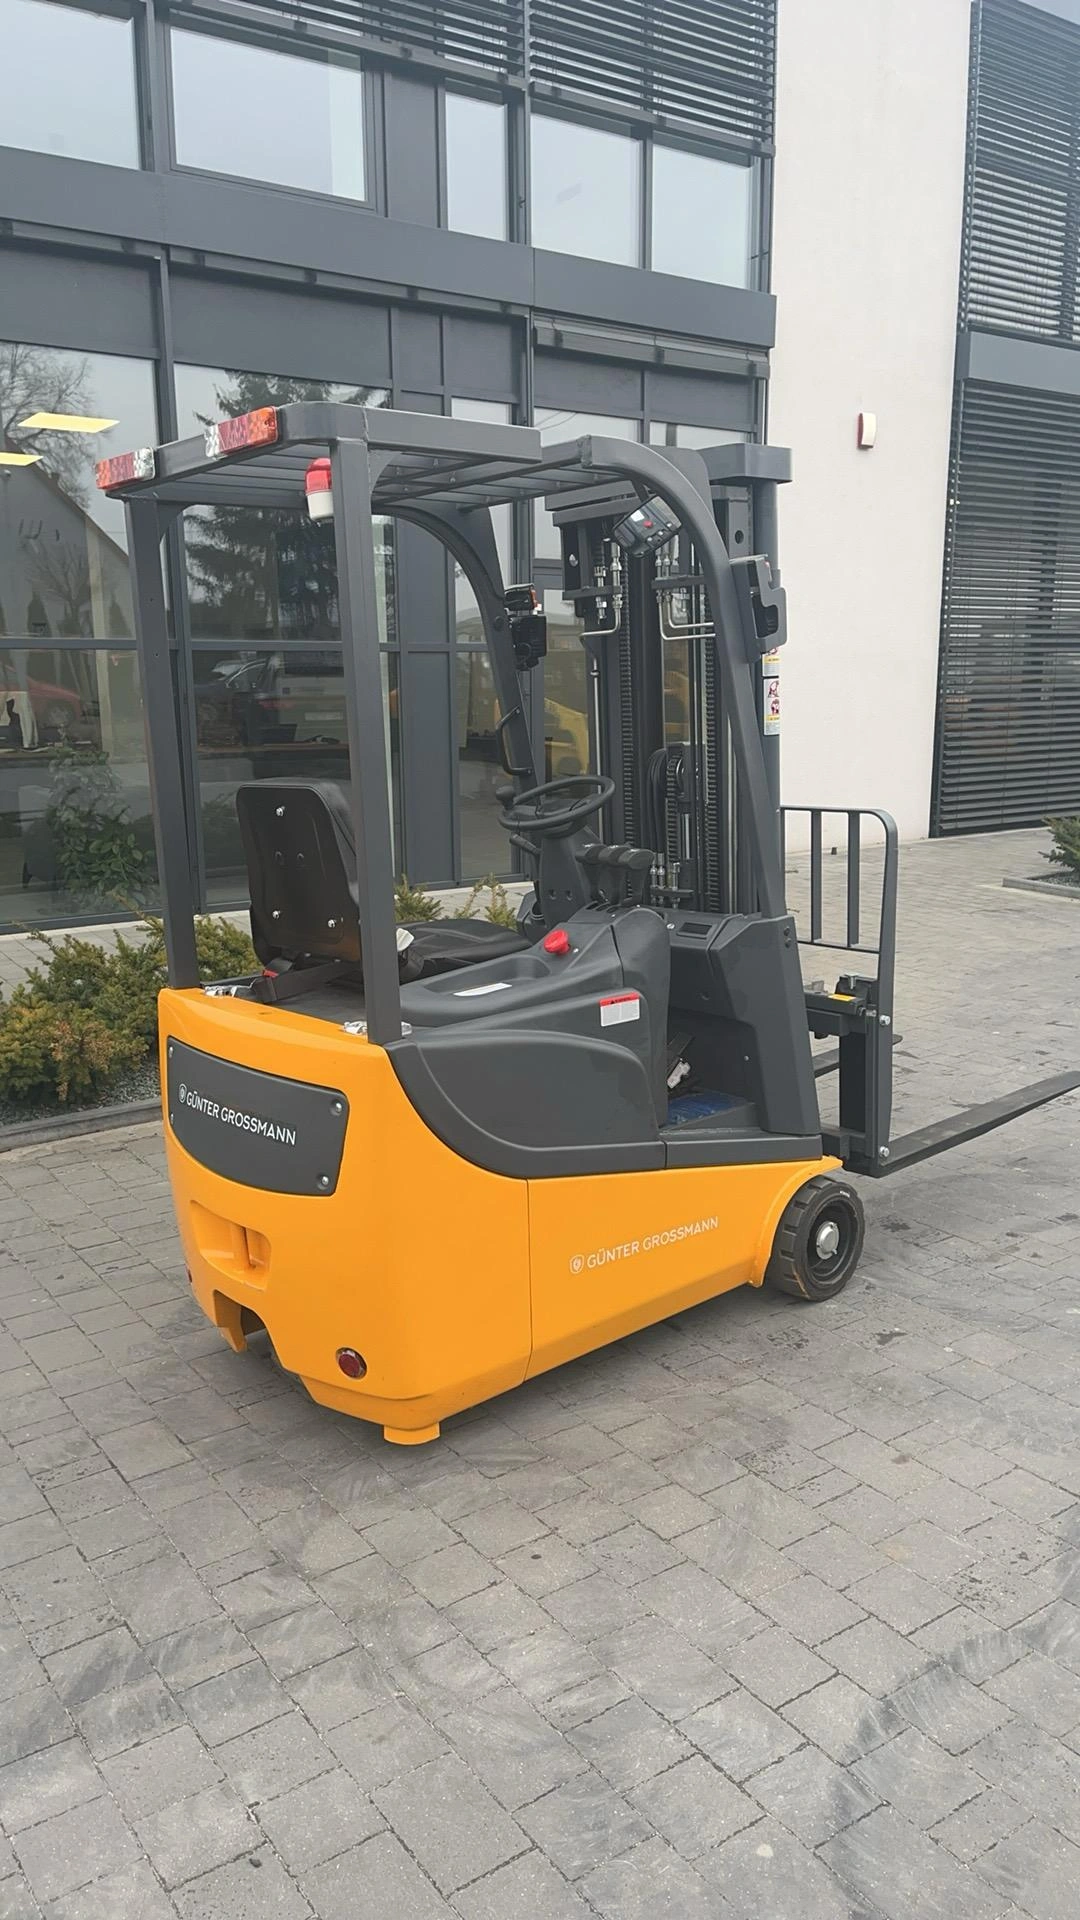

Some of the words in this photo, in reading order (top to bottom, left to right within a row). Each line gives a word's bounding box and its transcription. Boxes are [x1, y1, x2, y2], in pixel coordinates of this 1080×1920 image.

[186, 1091, 219, 1118] GÜNTER
[220, 1107, 296, 1145] GROSSMANN
[586, 1241, 640, 1268] GÜNTER
[642, 1216, 719, 1250] GROSSMANN
